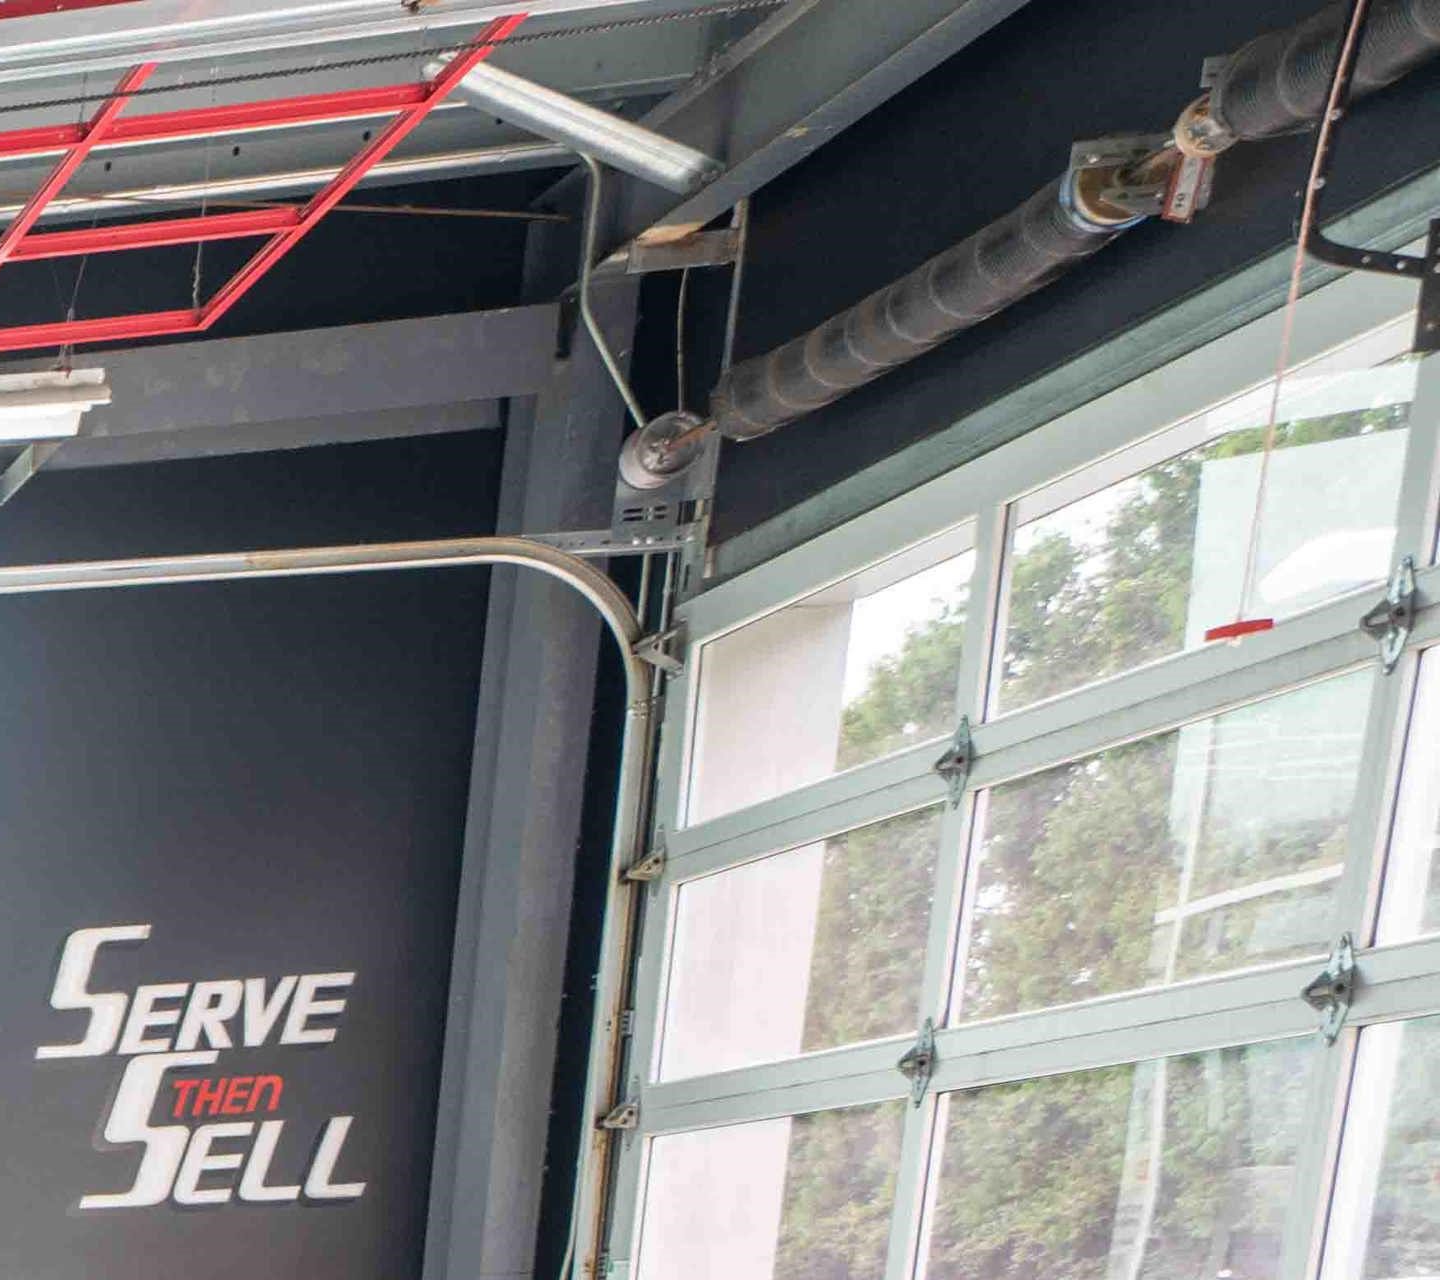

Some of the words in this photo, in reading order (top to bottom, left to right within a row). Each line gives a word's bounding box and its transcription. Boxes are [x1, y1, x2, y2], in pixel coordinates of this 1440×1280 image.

[35, 924, 356, 1059] SERVE
[79, 1050, 367, 1209] SELL
[173, 1074, 284, 1118] THEN
